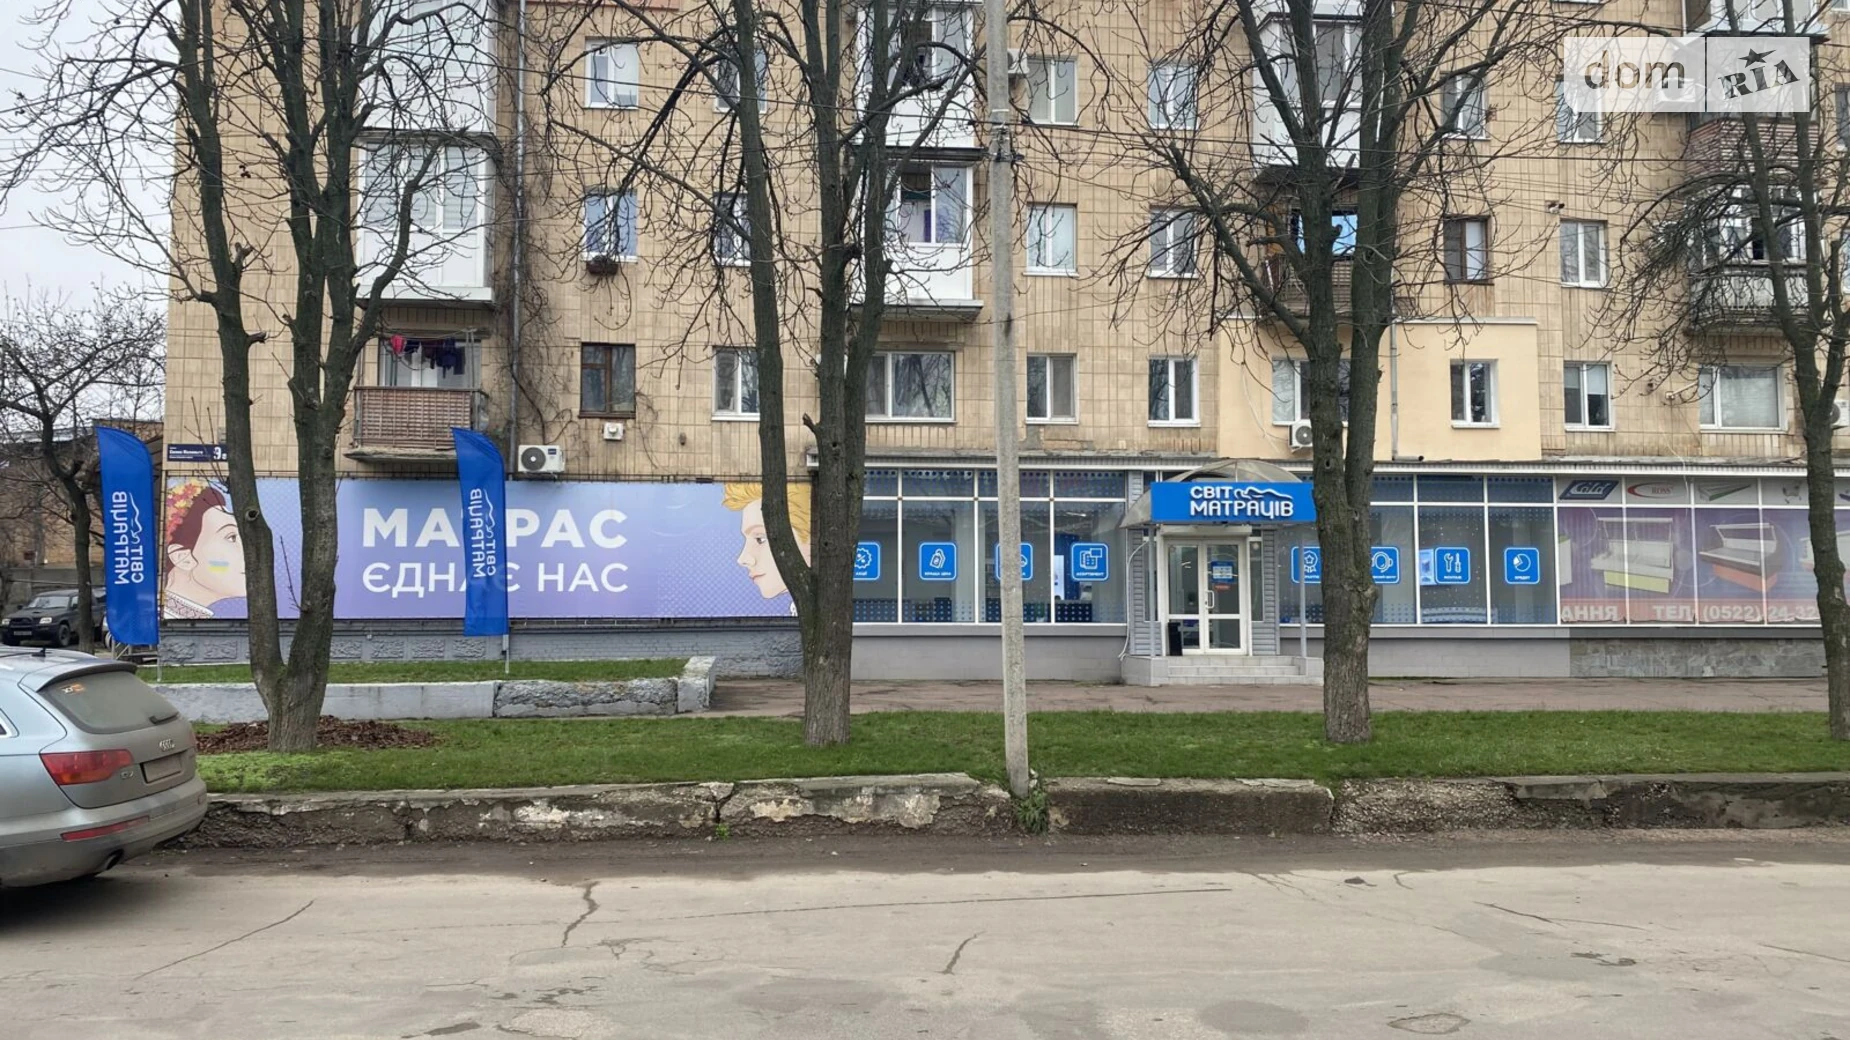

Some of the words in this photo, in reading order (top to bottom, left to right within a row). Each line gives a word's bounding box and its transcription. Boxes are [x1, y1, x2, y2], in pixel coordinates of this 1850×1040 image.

[1190, 486, 1233, 499] СВІТ
[1190, 500, 1294, 519] МАТРАЦІВ
[362, 507, 628, 549] МАРАС
[537, 562, 629, 593] НАС
